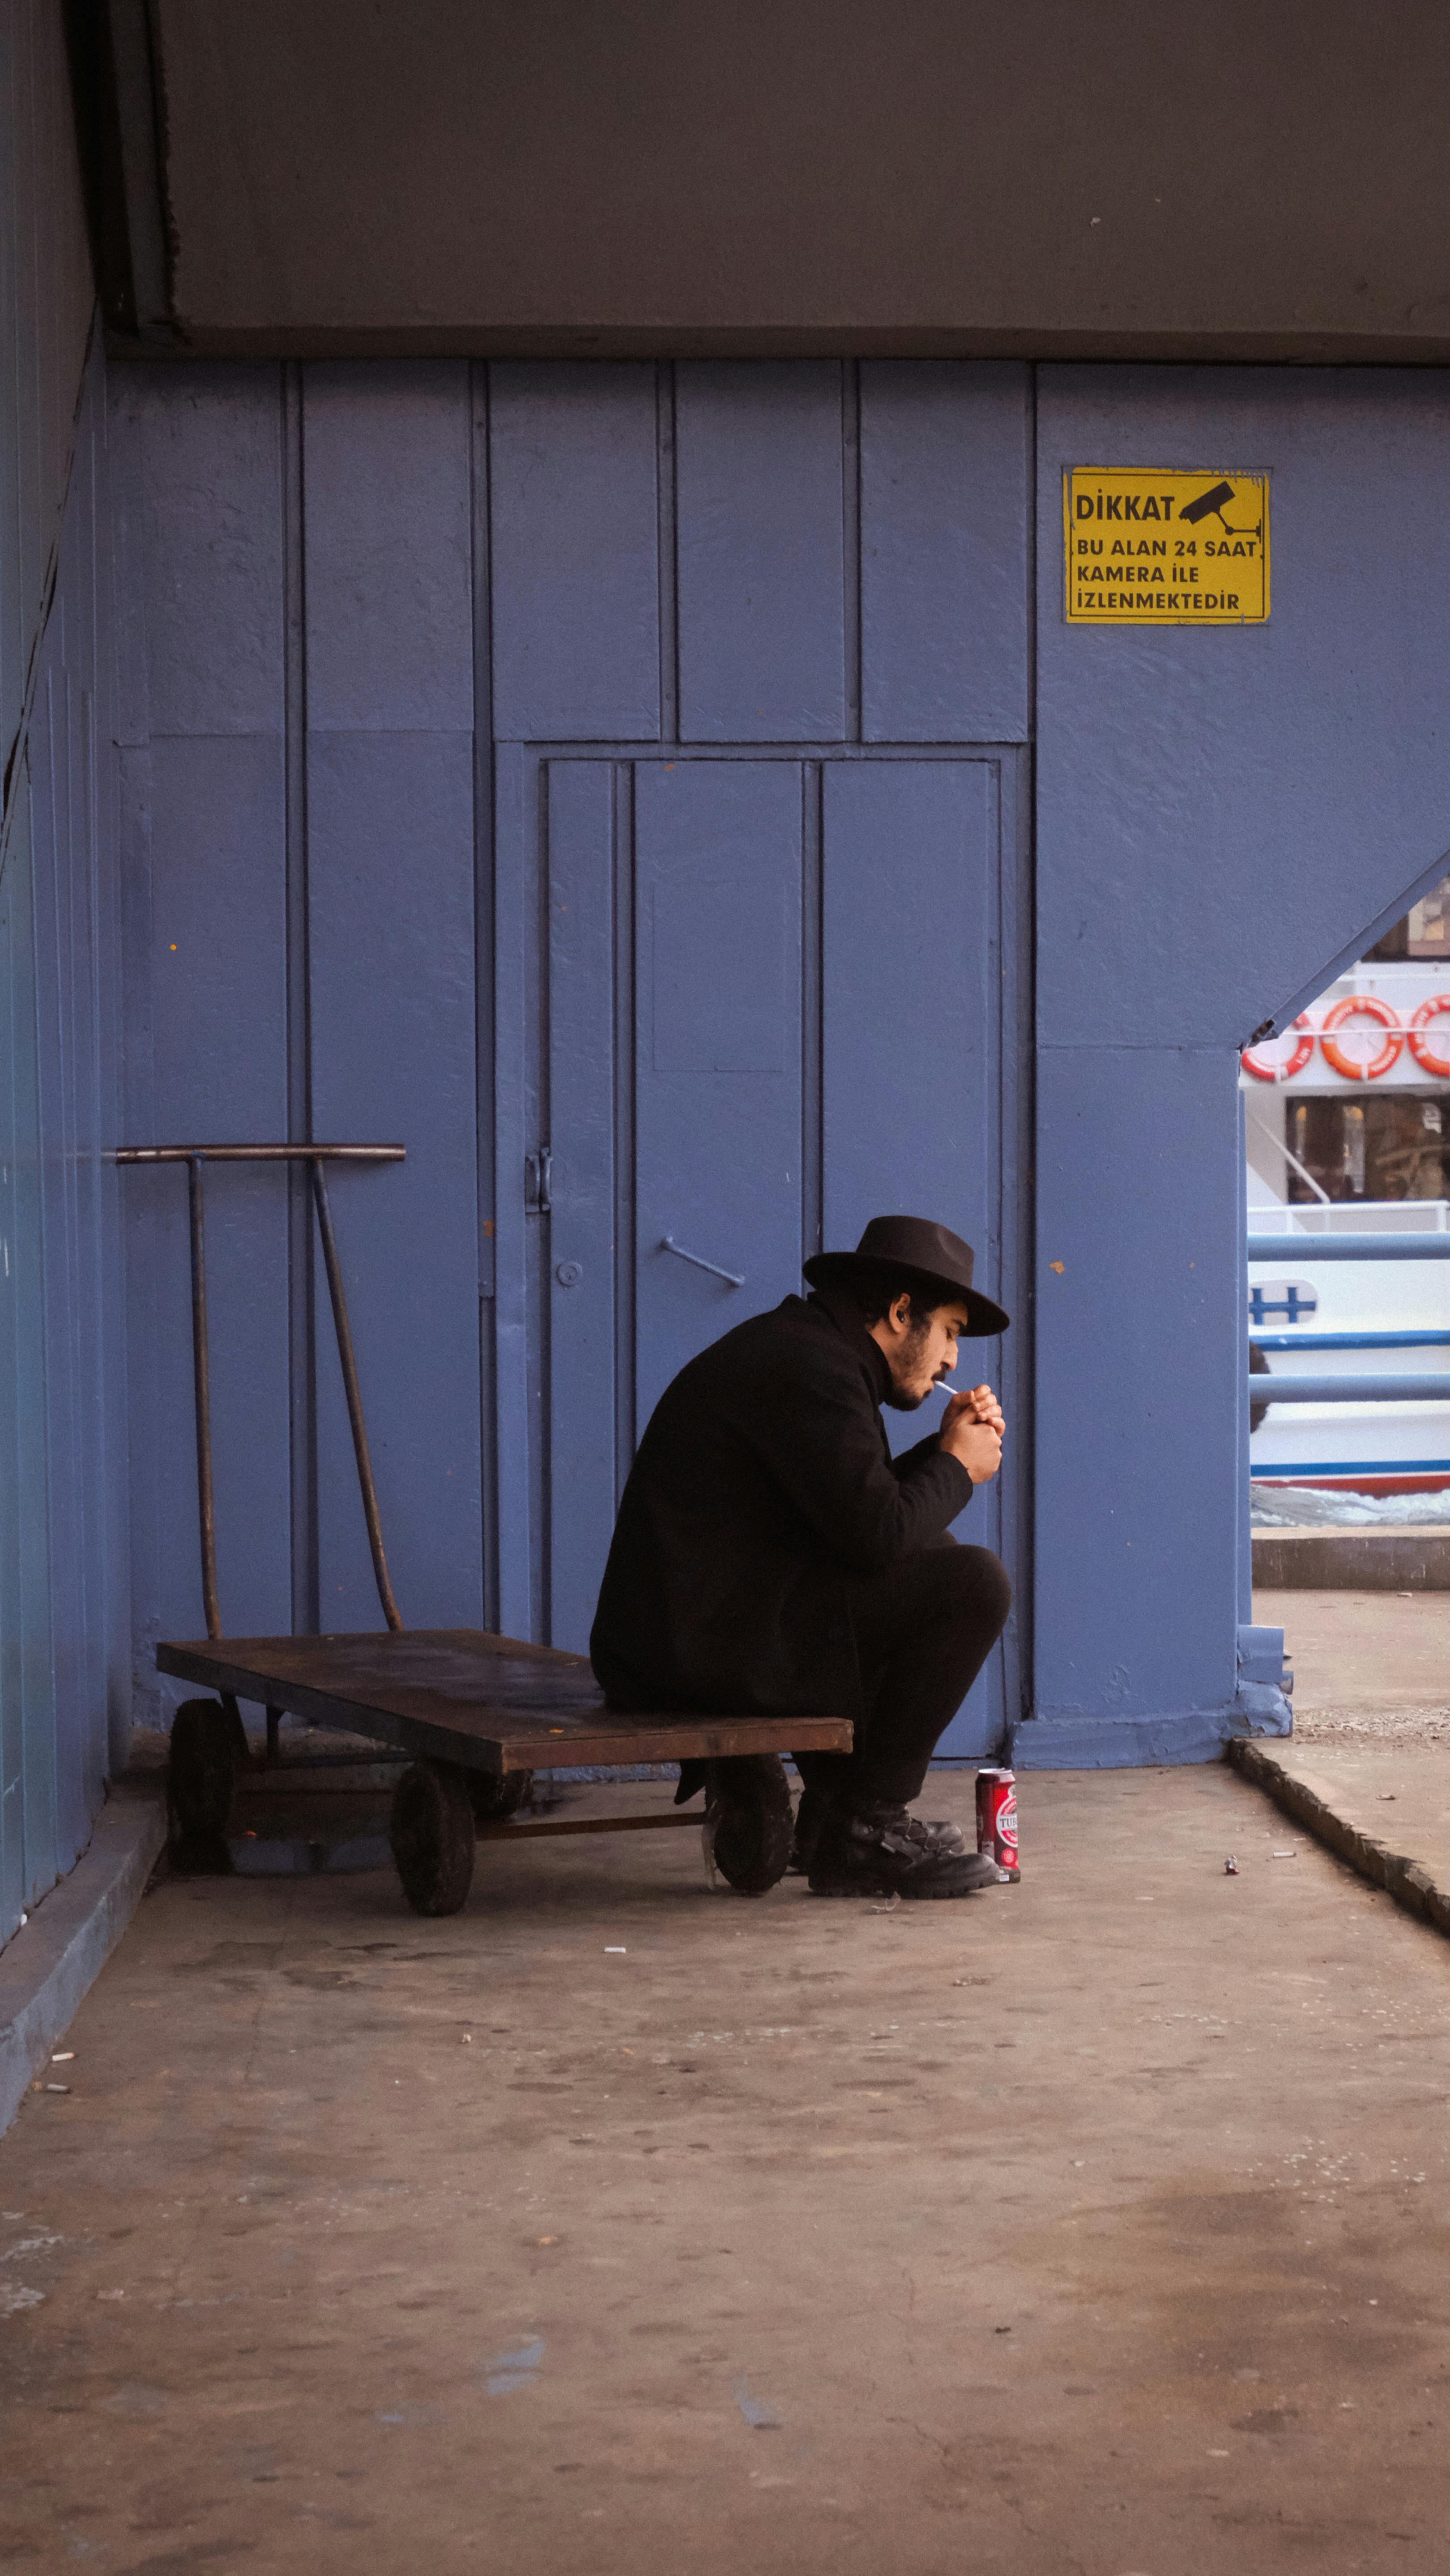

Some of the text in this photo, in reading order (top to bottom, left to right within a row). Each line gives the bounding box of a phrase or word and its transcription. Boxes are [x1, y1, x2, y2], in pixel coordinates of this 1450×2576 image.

[1076, 489, 1175, 520] DİKKAT
[1078, 539, 1256, 557] BU ALAN 24 SAAT
[1078, 563, 1198, 583] KAMERA İLE
[1078, 589, 1239, 609] İZLENMEKTEDİR
